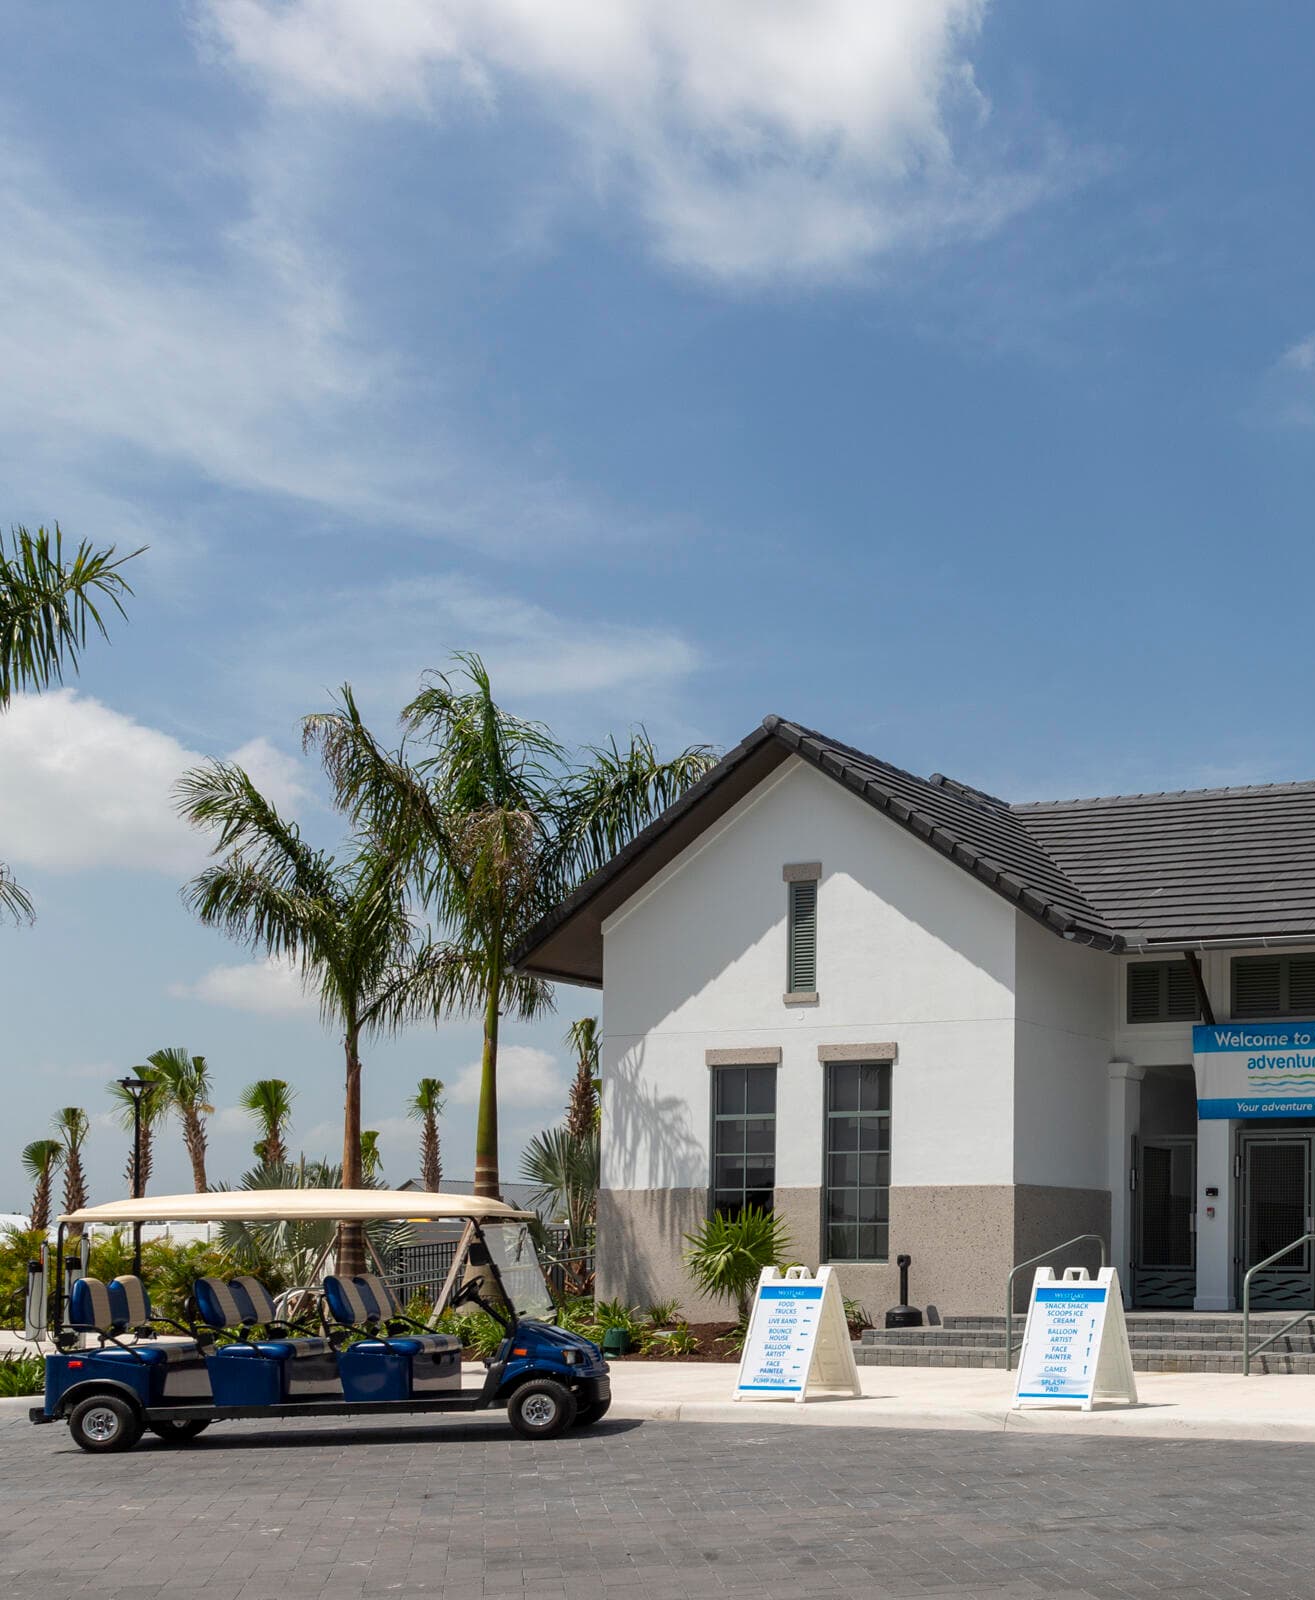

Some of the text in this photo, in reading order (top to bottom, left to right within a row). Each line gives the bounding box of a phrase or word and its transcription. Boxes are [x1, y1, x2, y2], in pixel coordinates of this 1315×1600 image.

[1214, 1031, 1289, 1048] Welcome
[1293, 1031, 1311, 1045] to
[1237, 1102, 1259, 1112] Your
[1261, 1102, 1313, 1112] adventure
